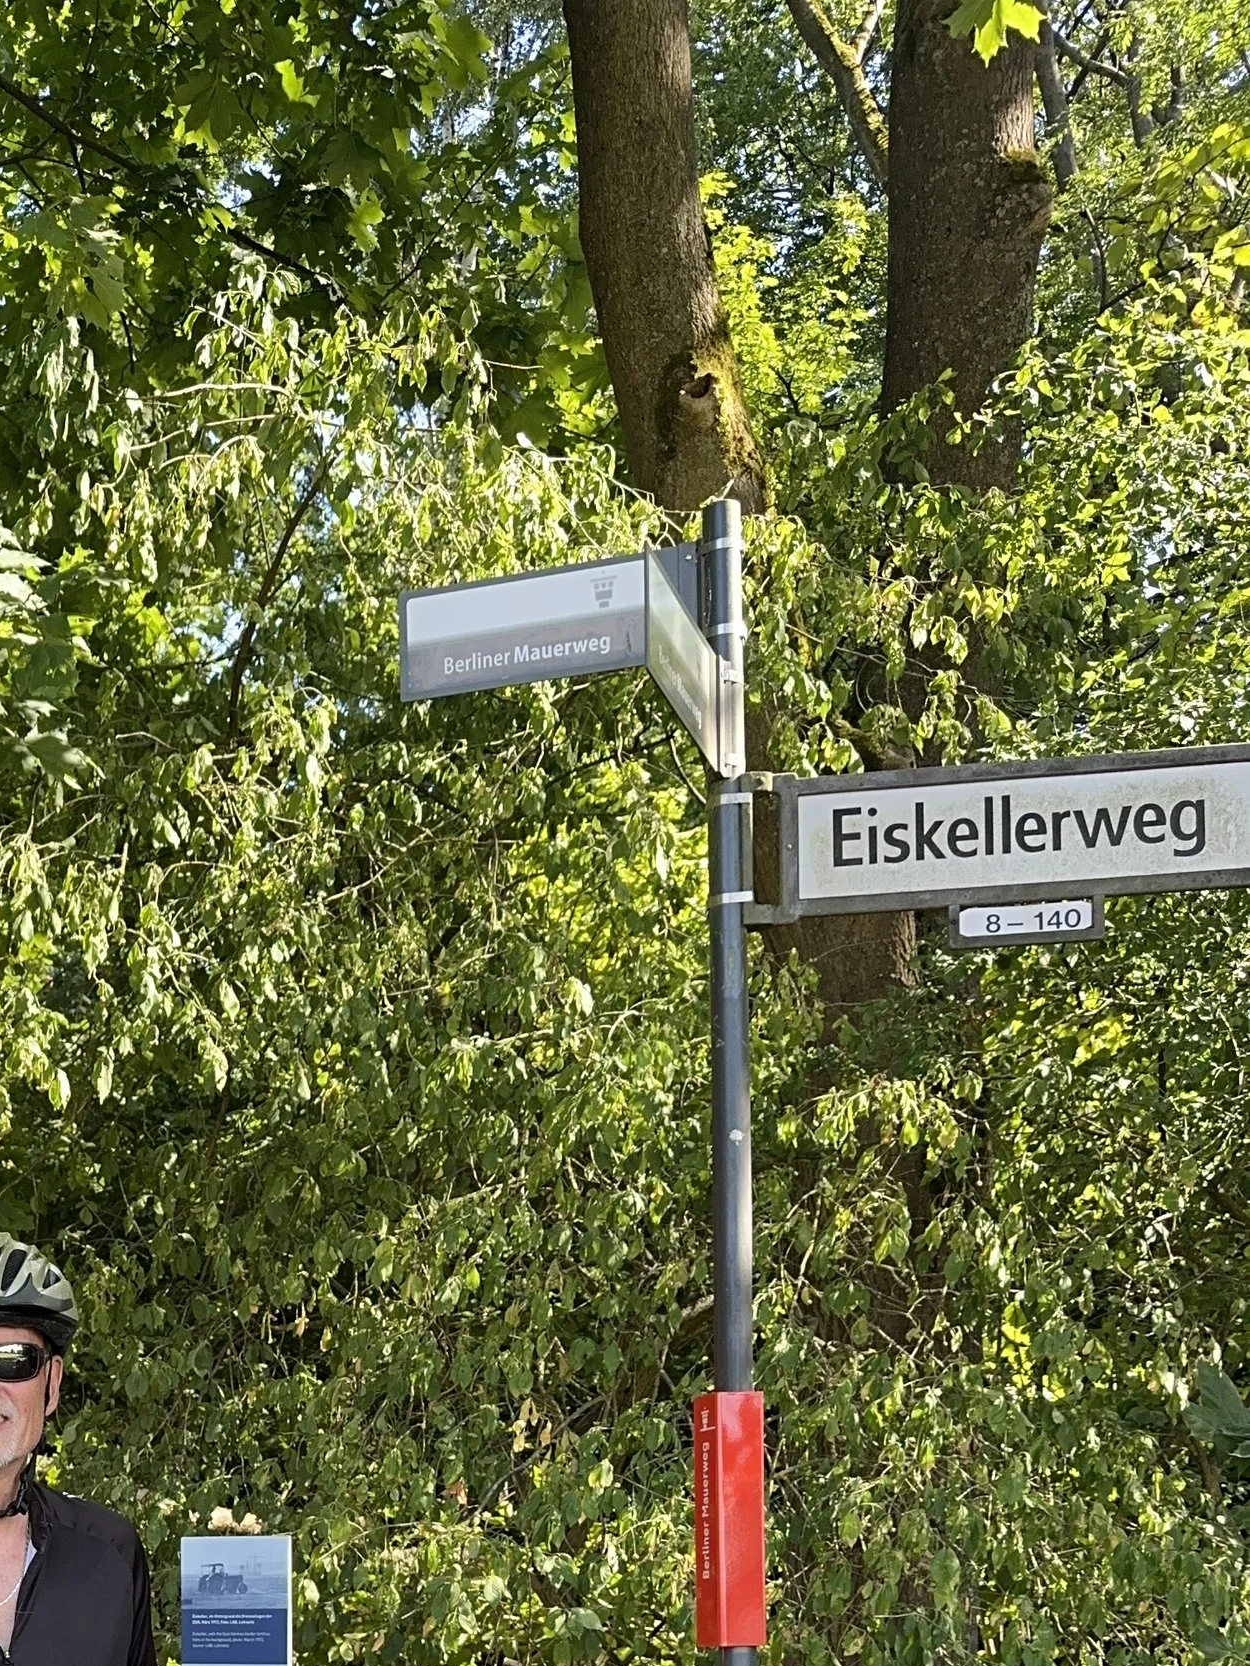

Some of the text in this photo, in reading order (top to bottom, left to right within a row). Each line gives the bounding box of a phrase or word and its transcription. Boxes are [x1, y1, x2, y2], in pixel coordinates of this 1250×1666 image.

[443, 634, 612, 675] Berliner Mauerweg
[832, 794, 1207, 868] Eiskellerweg
[986, 913, 1001, 934] 8
[1034, 908, 1082, 931] 140
[701, 1441, 711, 1580] Berliner Mauerweg
